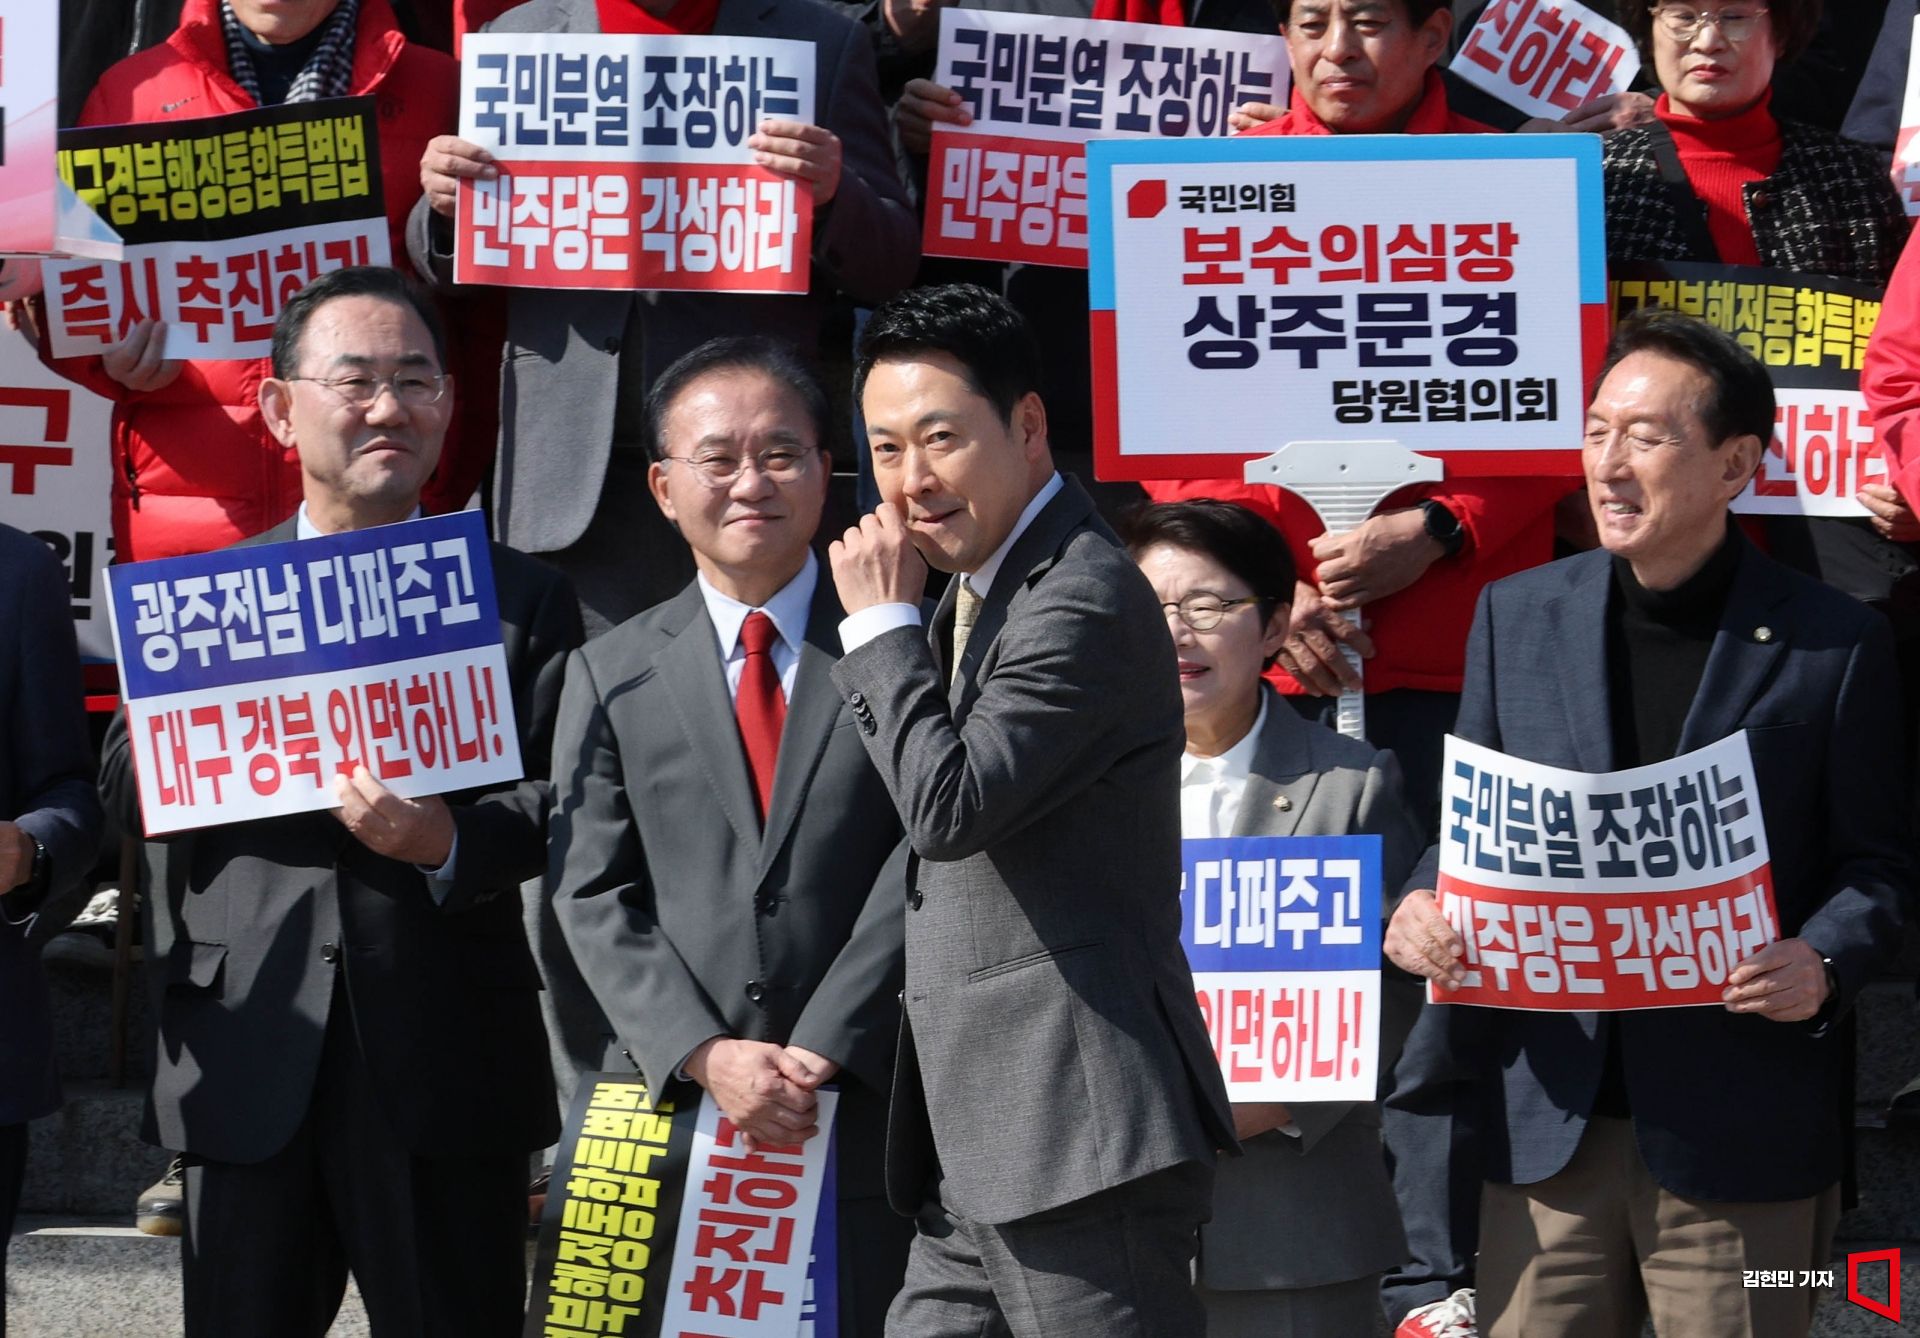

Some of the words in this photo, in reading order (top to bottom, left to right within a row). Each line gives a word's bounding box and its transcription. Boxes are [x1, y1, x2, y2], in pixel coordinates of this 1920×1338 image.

[475, 53, 629, 146] 국민분열
[642, 55, 799, 148] 조장하는
[951, 28, 1108, 130] 국민분열
[1116, 43, 1273, 137] 조장하는
[472, 174, 630, 271] 민주당은
[641, 177, 798, 273] 각성하라
[940, 147, 1088, 249] 민주당은
[1179, 183, 1296, 213] 국민의힘
[60, 258, 161, 343] 즉시
[176, 235, 369, 343] 추진하
[1182, 222, 1519, 285] 보수의심장
[1183, 291, 1519, 370] 상주문경
[1332, 377, 1558, 424] 당원협의회
[131, 568, 306, 672] 광주전남
[308, 537, 480, 646] 다퍼주고
[328, 664, 504, 780] 외면하나!
[1450, 760, 1585, 879] 국민분열
[1587, 764, 1757, 879] 조장하는
[1194, 858, 1363, 951] 다퍼주고
[1604, 883, 1777, 993] 각성하라
